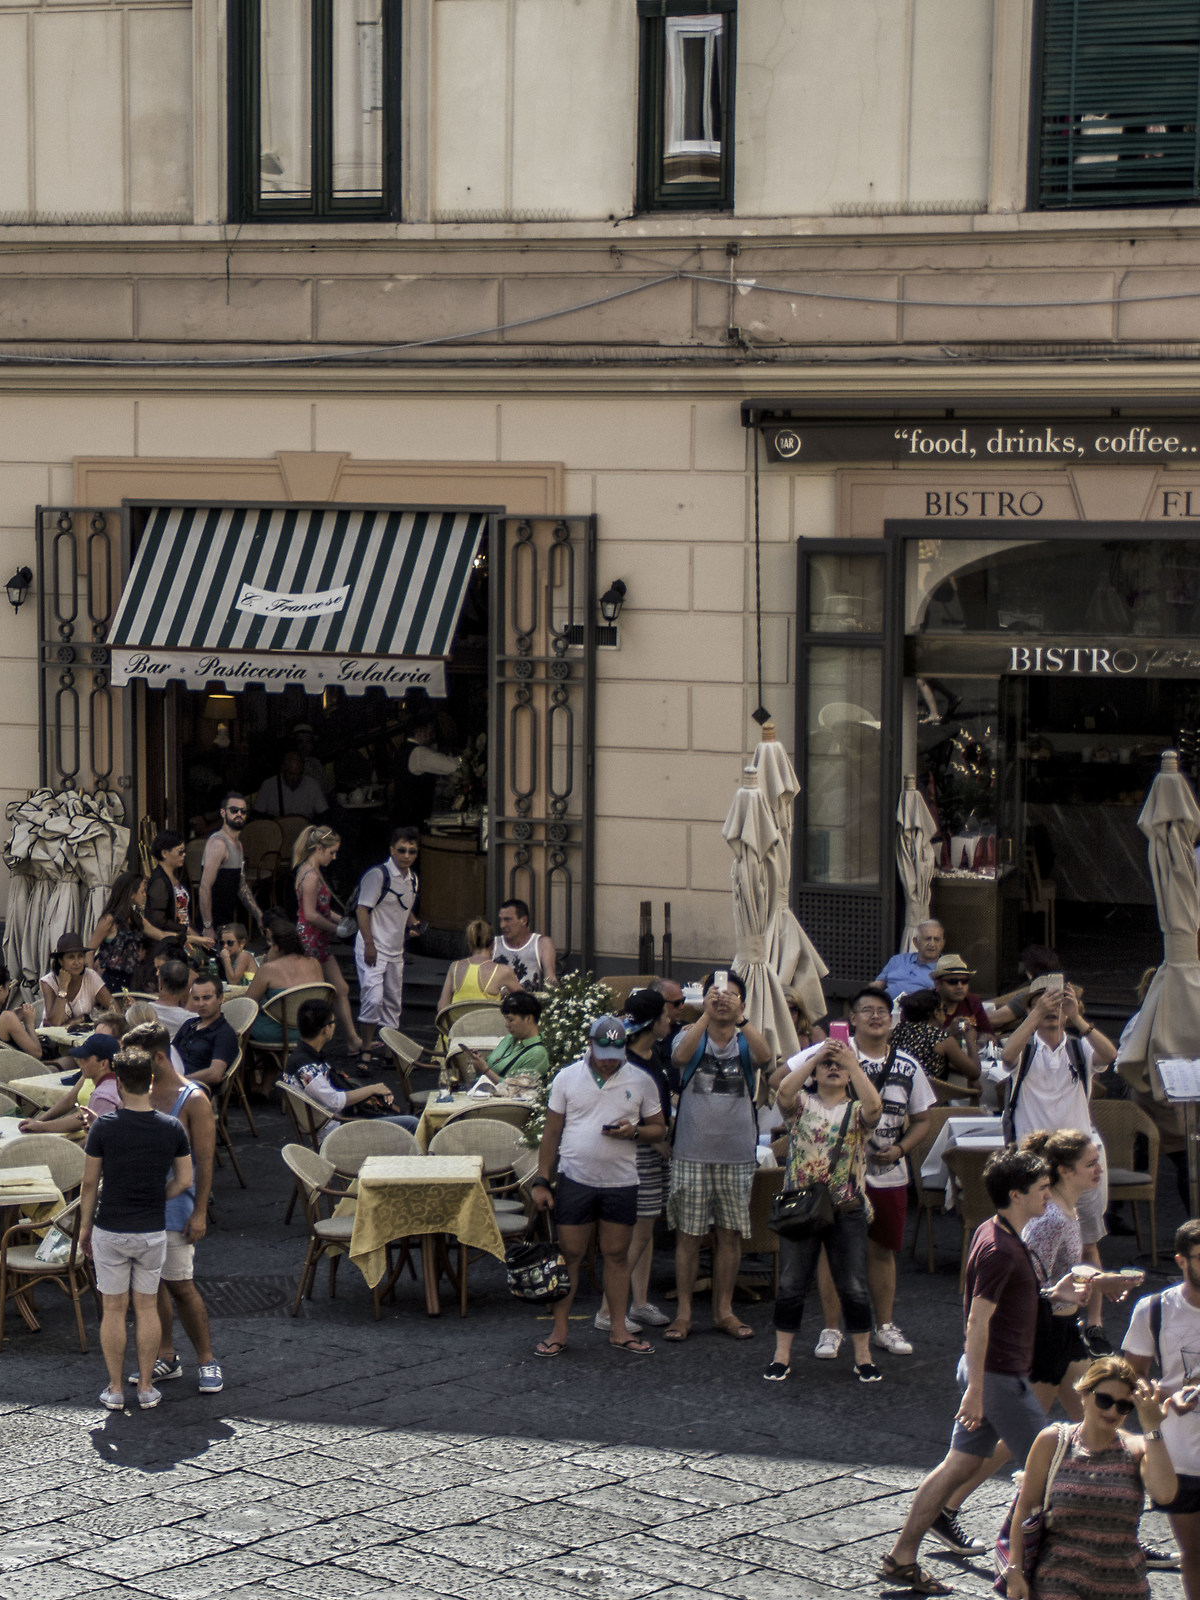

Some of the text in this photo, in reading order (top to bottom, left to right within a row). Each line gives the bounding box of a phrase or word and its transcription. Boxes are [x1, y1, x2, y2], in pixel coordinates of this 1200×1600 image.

[780, 437, 794, 449] BAR
[987, 428, 1085, 457] drinks,
[925, 491, 1043, 516] BISTRO
[241, 592, 342, 612] C. Francese
[124, 653, 431, 683] Bar Pasticceria Gelateria
[1010, 646, 1138, 673] BISTRO
